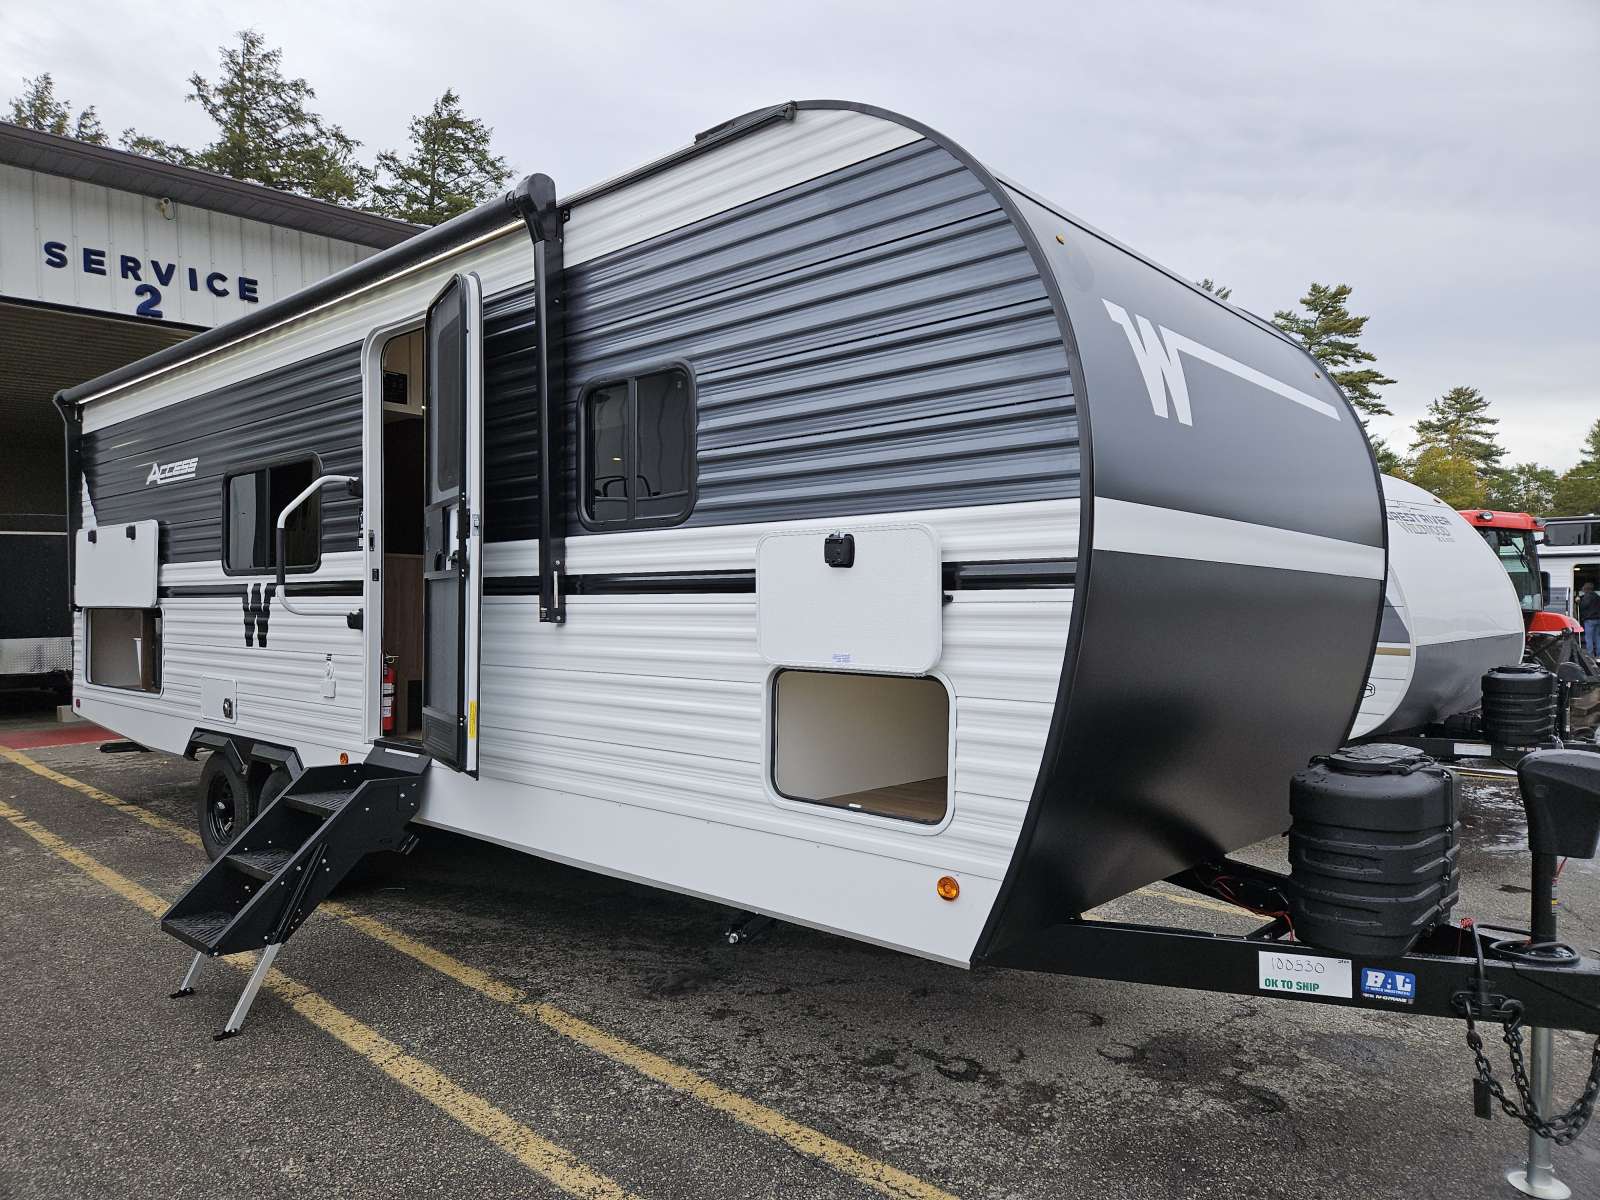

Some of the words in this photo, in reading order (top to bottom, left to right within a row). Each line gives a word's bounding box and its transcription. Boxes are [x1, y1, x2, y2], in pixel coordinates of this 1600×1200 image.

[44, 241, 259, 303] SERVICE
[135, 284, 163, 318] 2
[1264, 978, 1278, 988] OK
[1281, 979, 1293, 989] TO
[1296, 981, 1320, 992] SHIP
